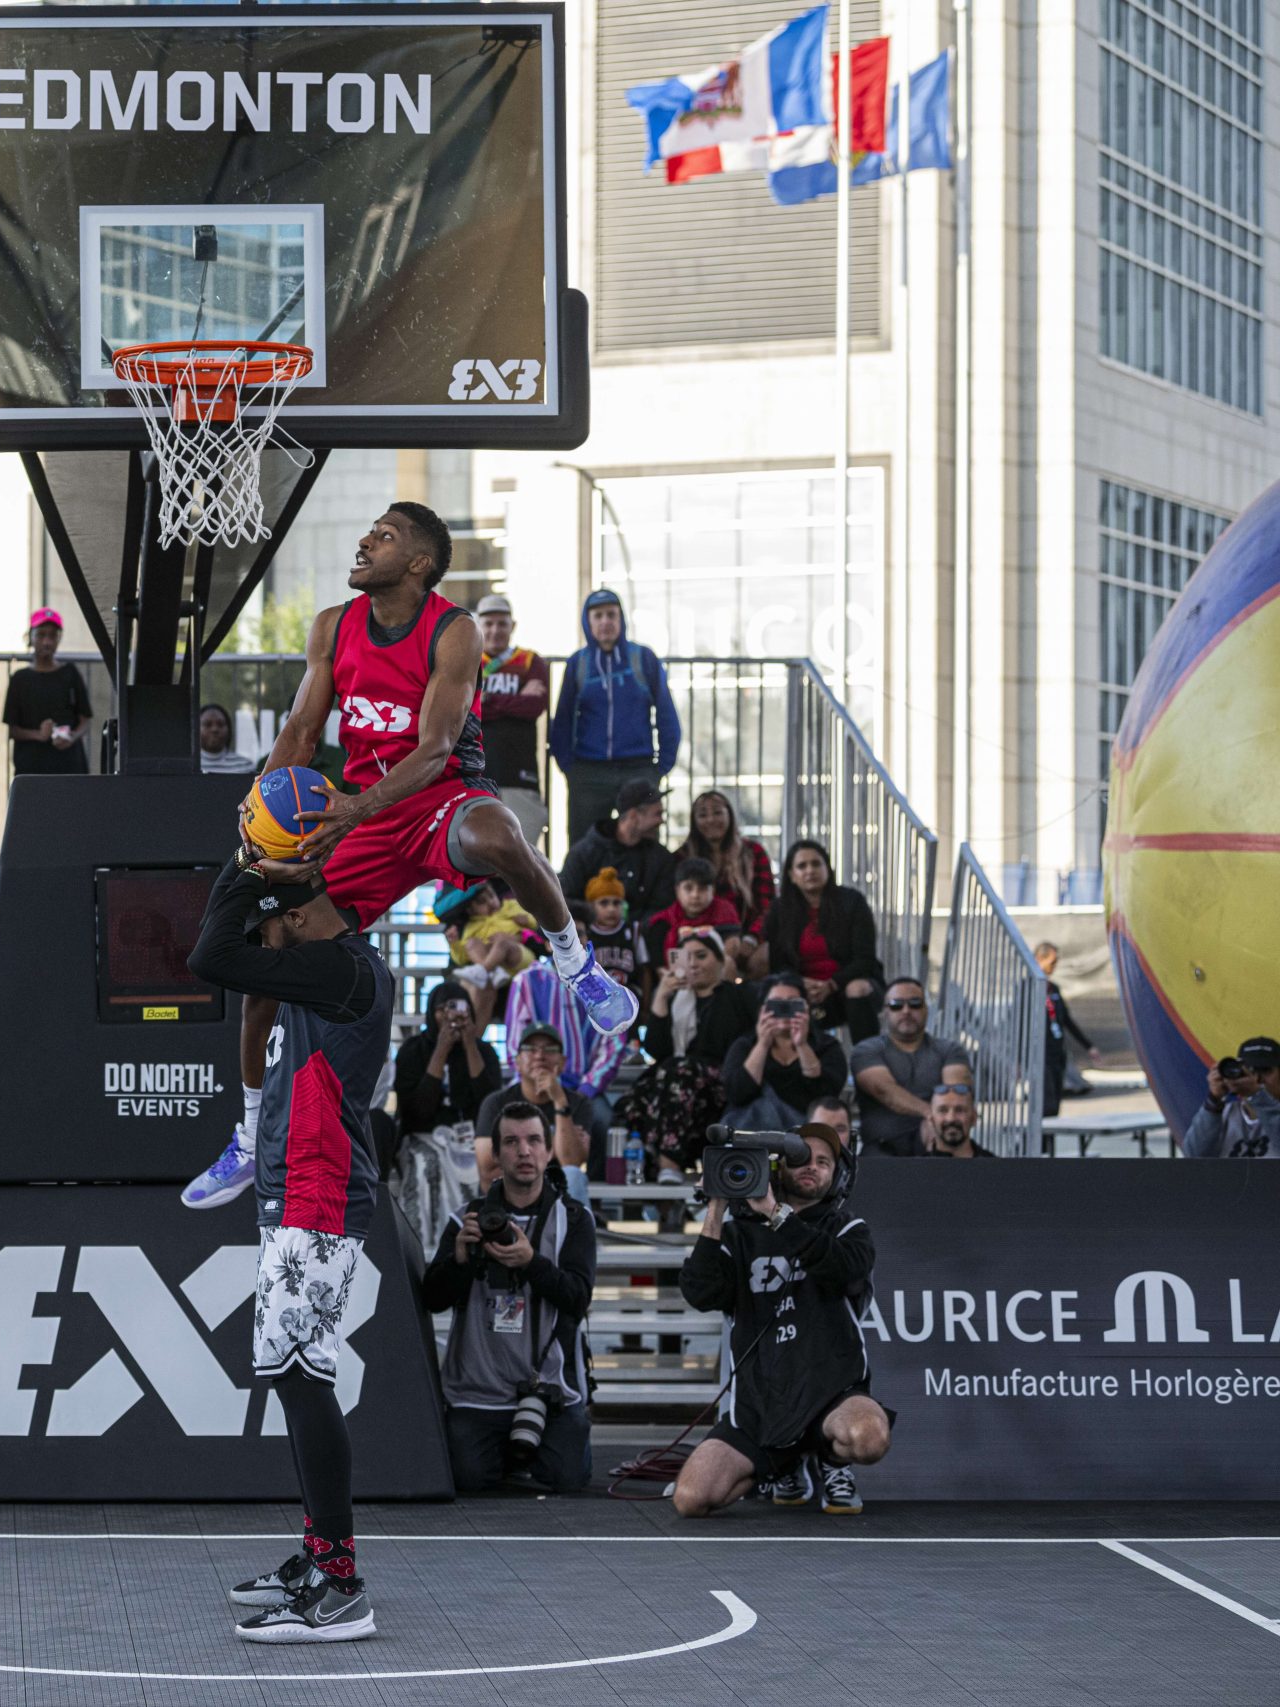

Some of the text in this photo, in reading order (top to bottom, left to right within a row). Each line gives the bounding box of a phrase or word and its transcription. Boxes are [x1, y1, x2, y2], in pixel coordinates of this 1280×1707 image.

[482, 672, 520, 694] TAH
[146, 1009, 176, 1018] Bodet
[104, 1062, 215, 1094] DO NORTH
[117, 1098, 200, 1118] EVENTS
[859, 1290, 1081, 1343] AURICE
[1229, 1278, 1280, 1343] L
[924, 1367, 1280, 1405] Manufacture Horlogère
